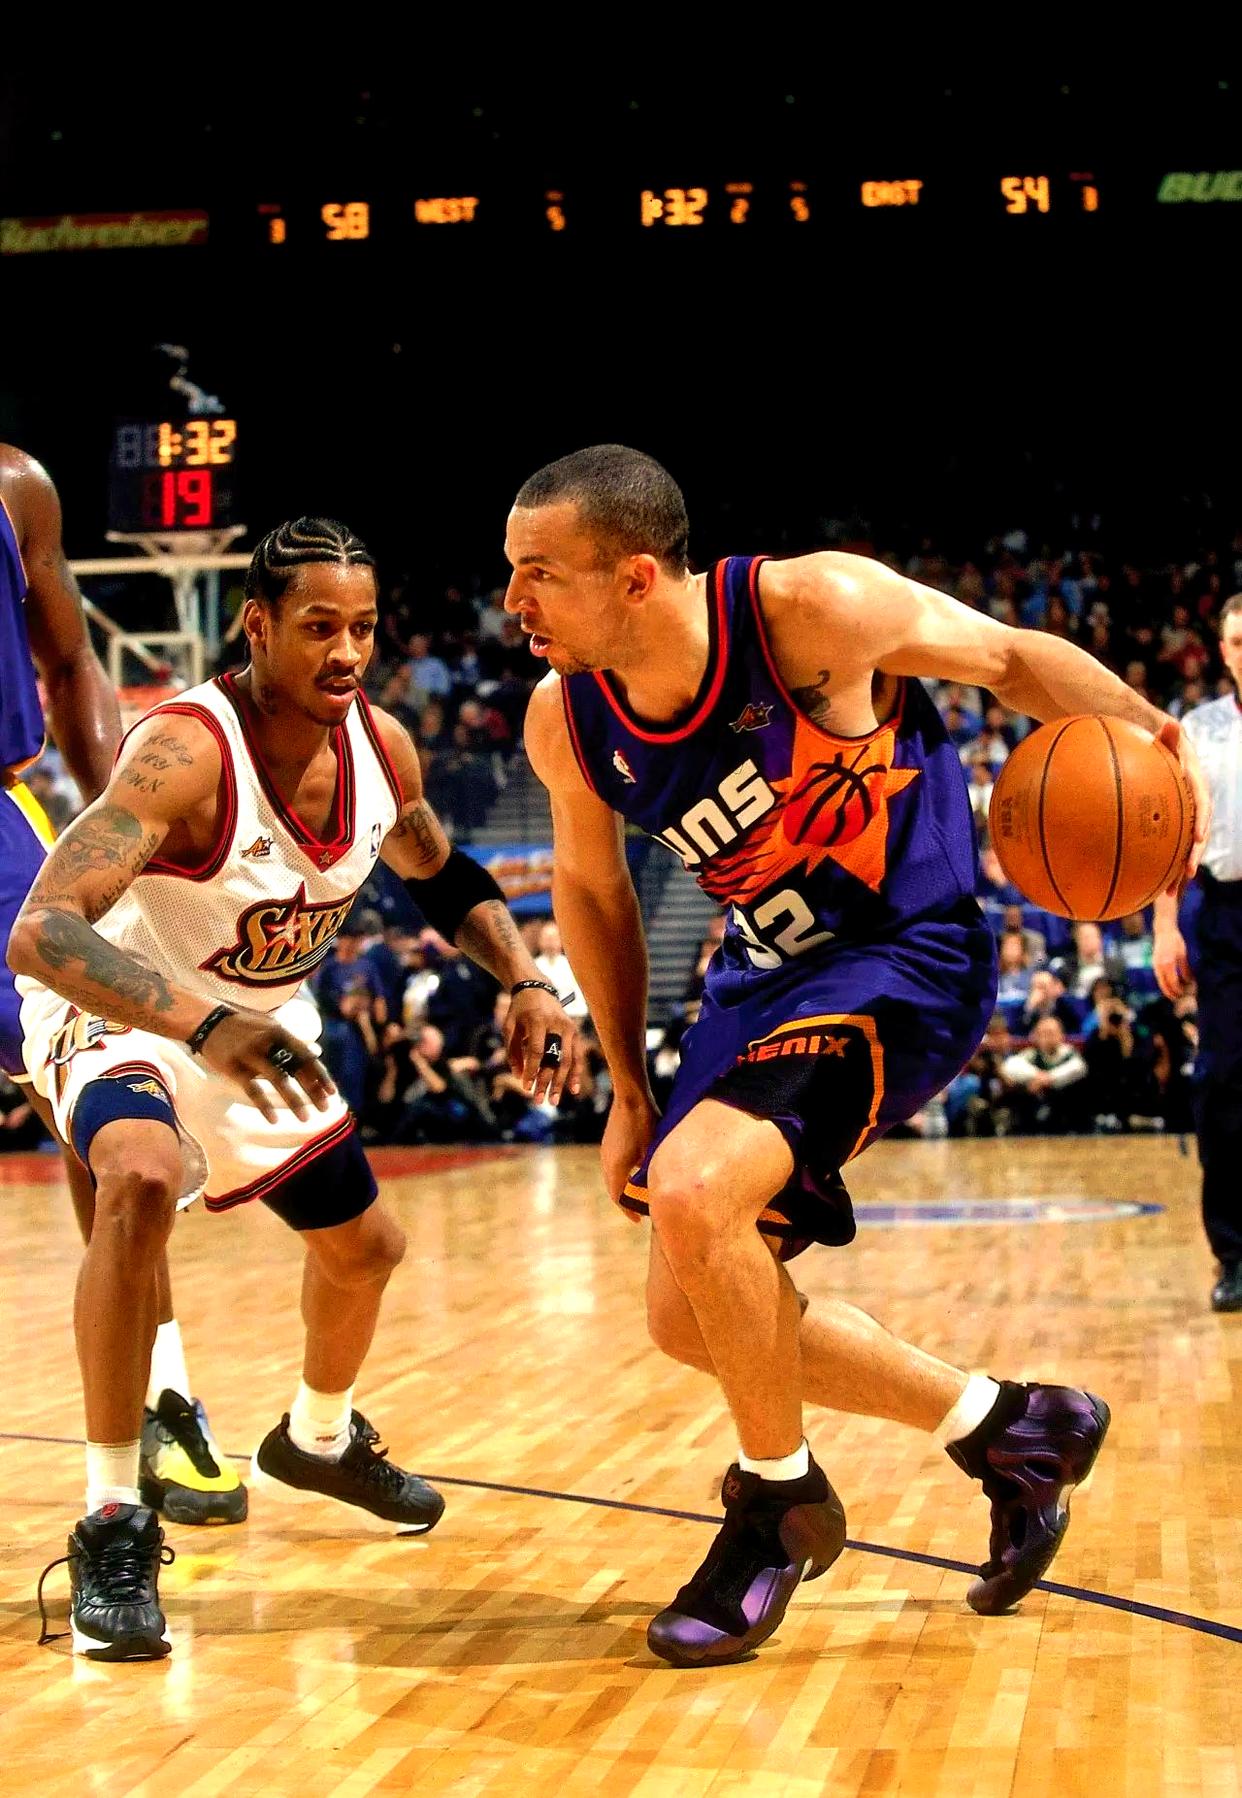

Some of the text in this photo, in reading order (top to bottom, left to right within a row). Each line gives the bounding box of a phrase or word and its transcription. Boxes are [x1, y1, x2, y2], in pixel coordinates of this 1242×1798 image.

[641, 187, 708, 227] 1:32
[1001, 176, 1050, 214] 54
[322, 202, 370, 241] 58
[158, 419, 237, 468] 1:32
[162, 469, 212, 528] 19
[650, 758, 776, 866] UNS
